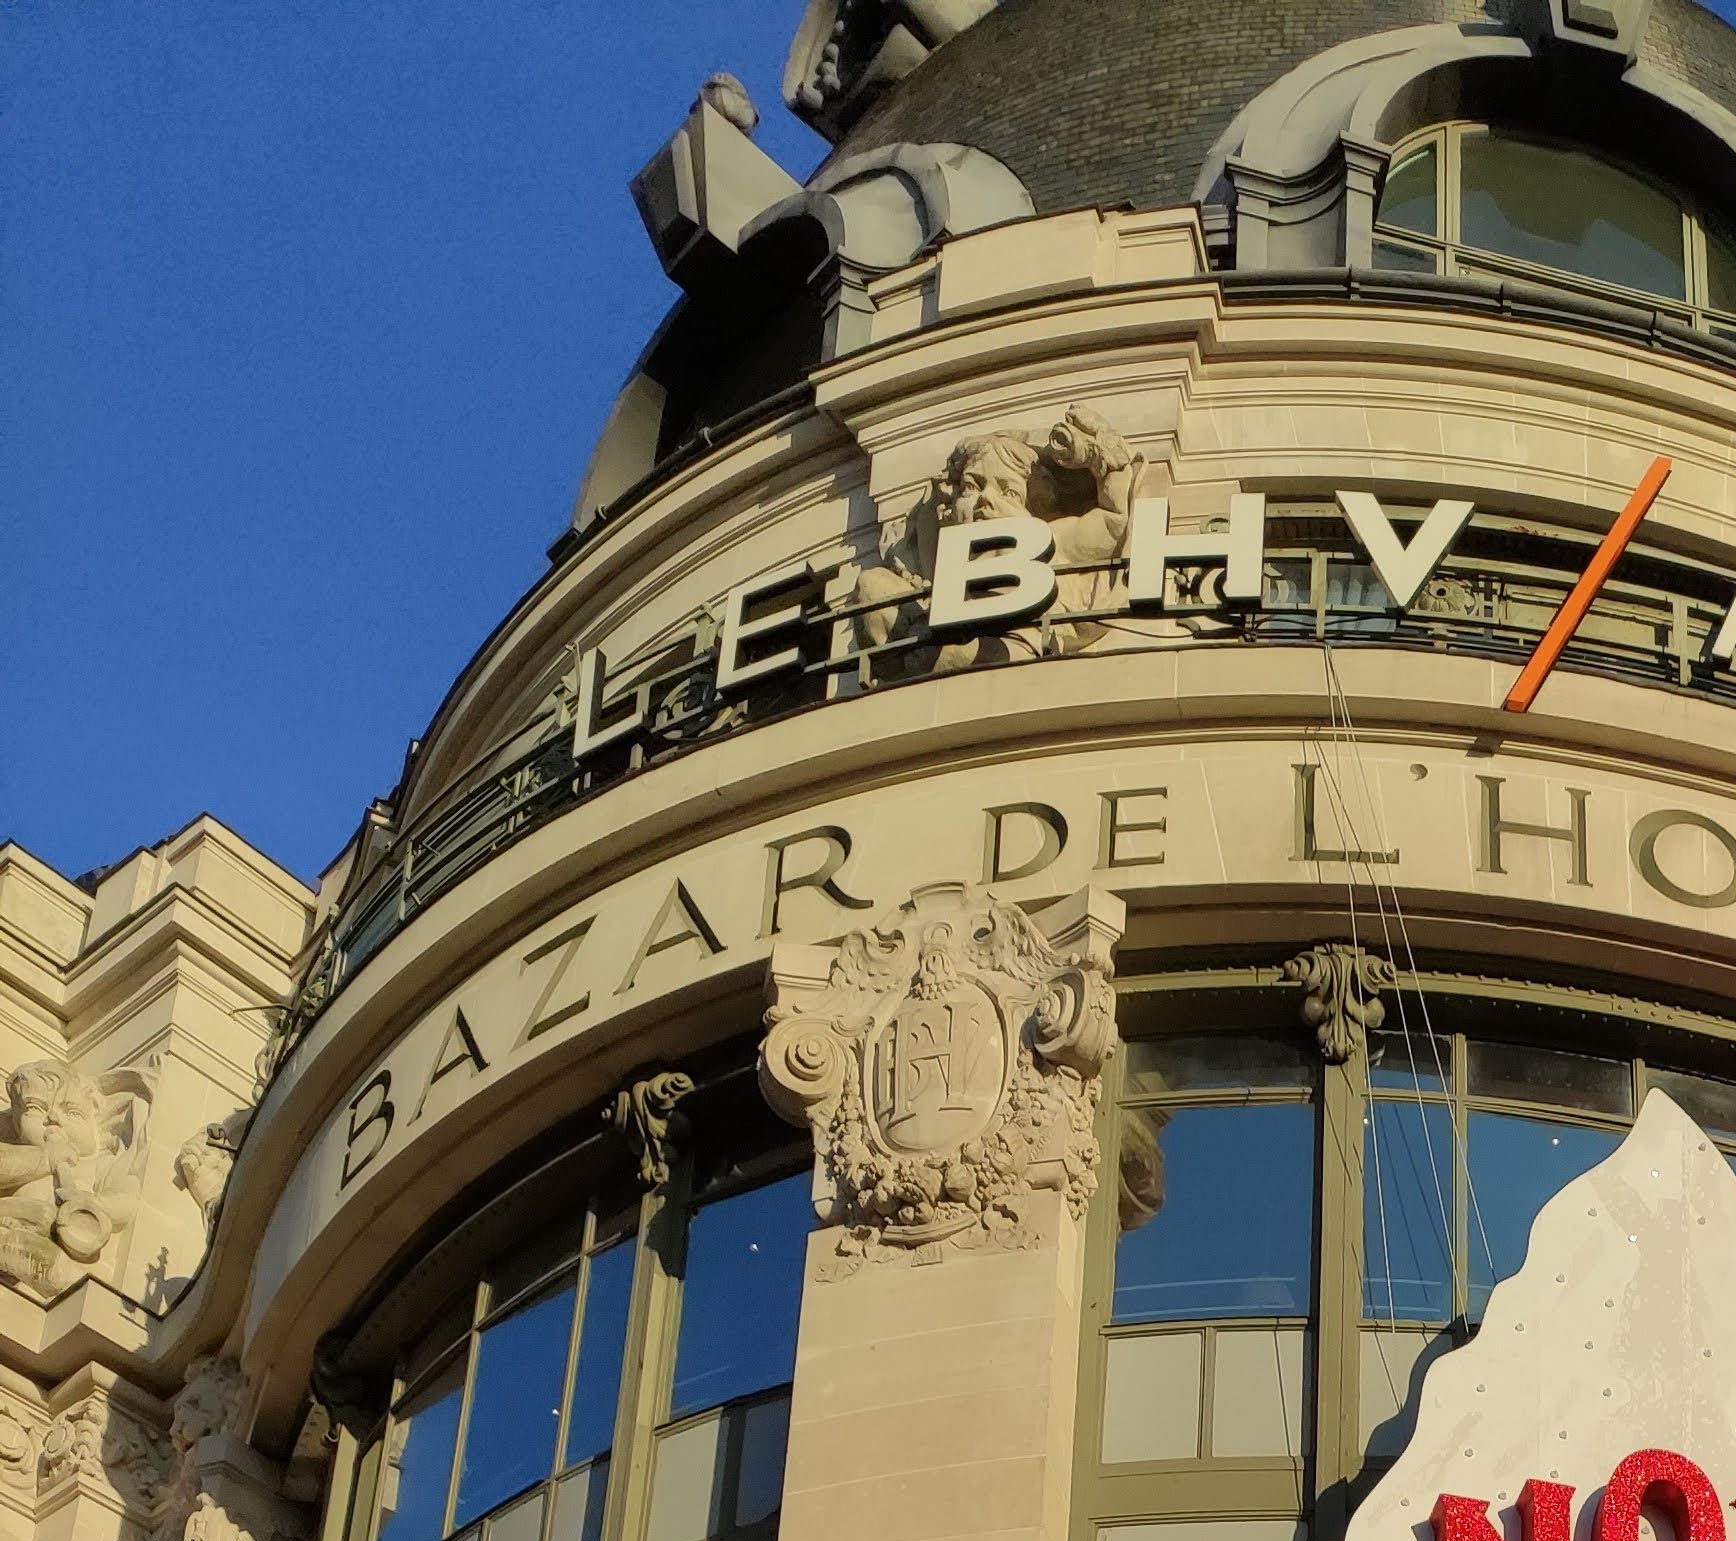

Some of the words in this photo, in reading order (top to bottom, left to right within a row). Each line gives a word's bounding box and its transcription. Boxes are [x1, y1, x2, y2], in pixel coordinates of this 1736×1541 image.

[573, 561, 815, 759] LE
[929, 490, 1475, 634] BHV
[336, 824, 875, 1197] BAZAR
[980, 786, 1168, 884] DE
